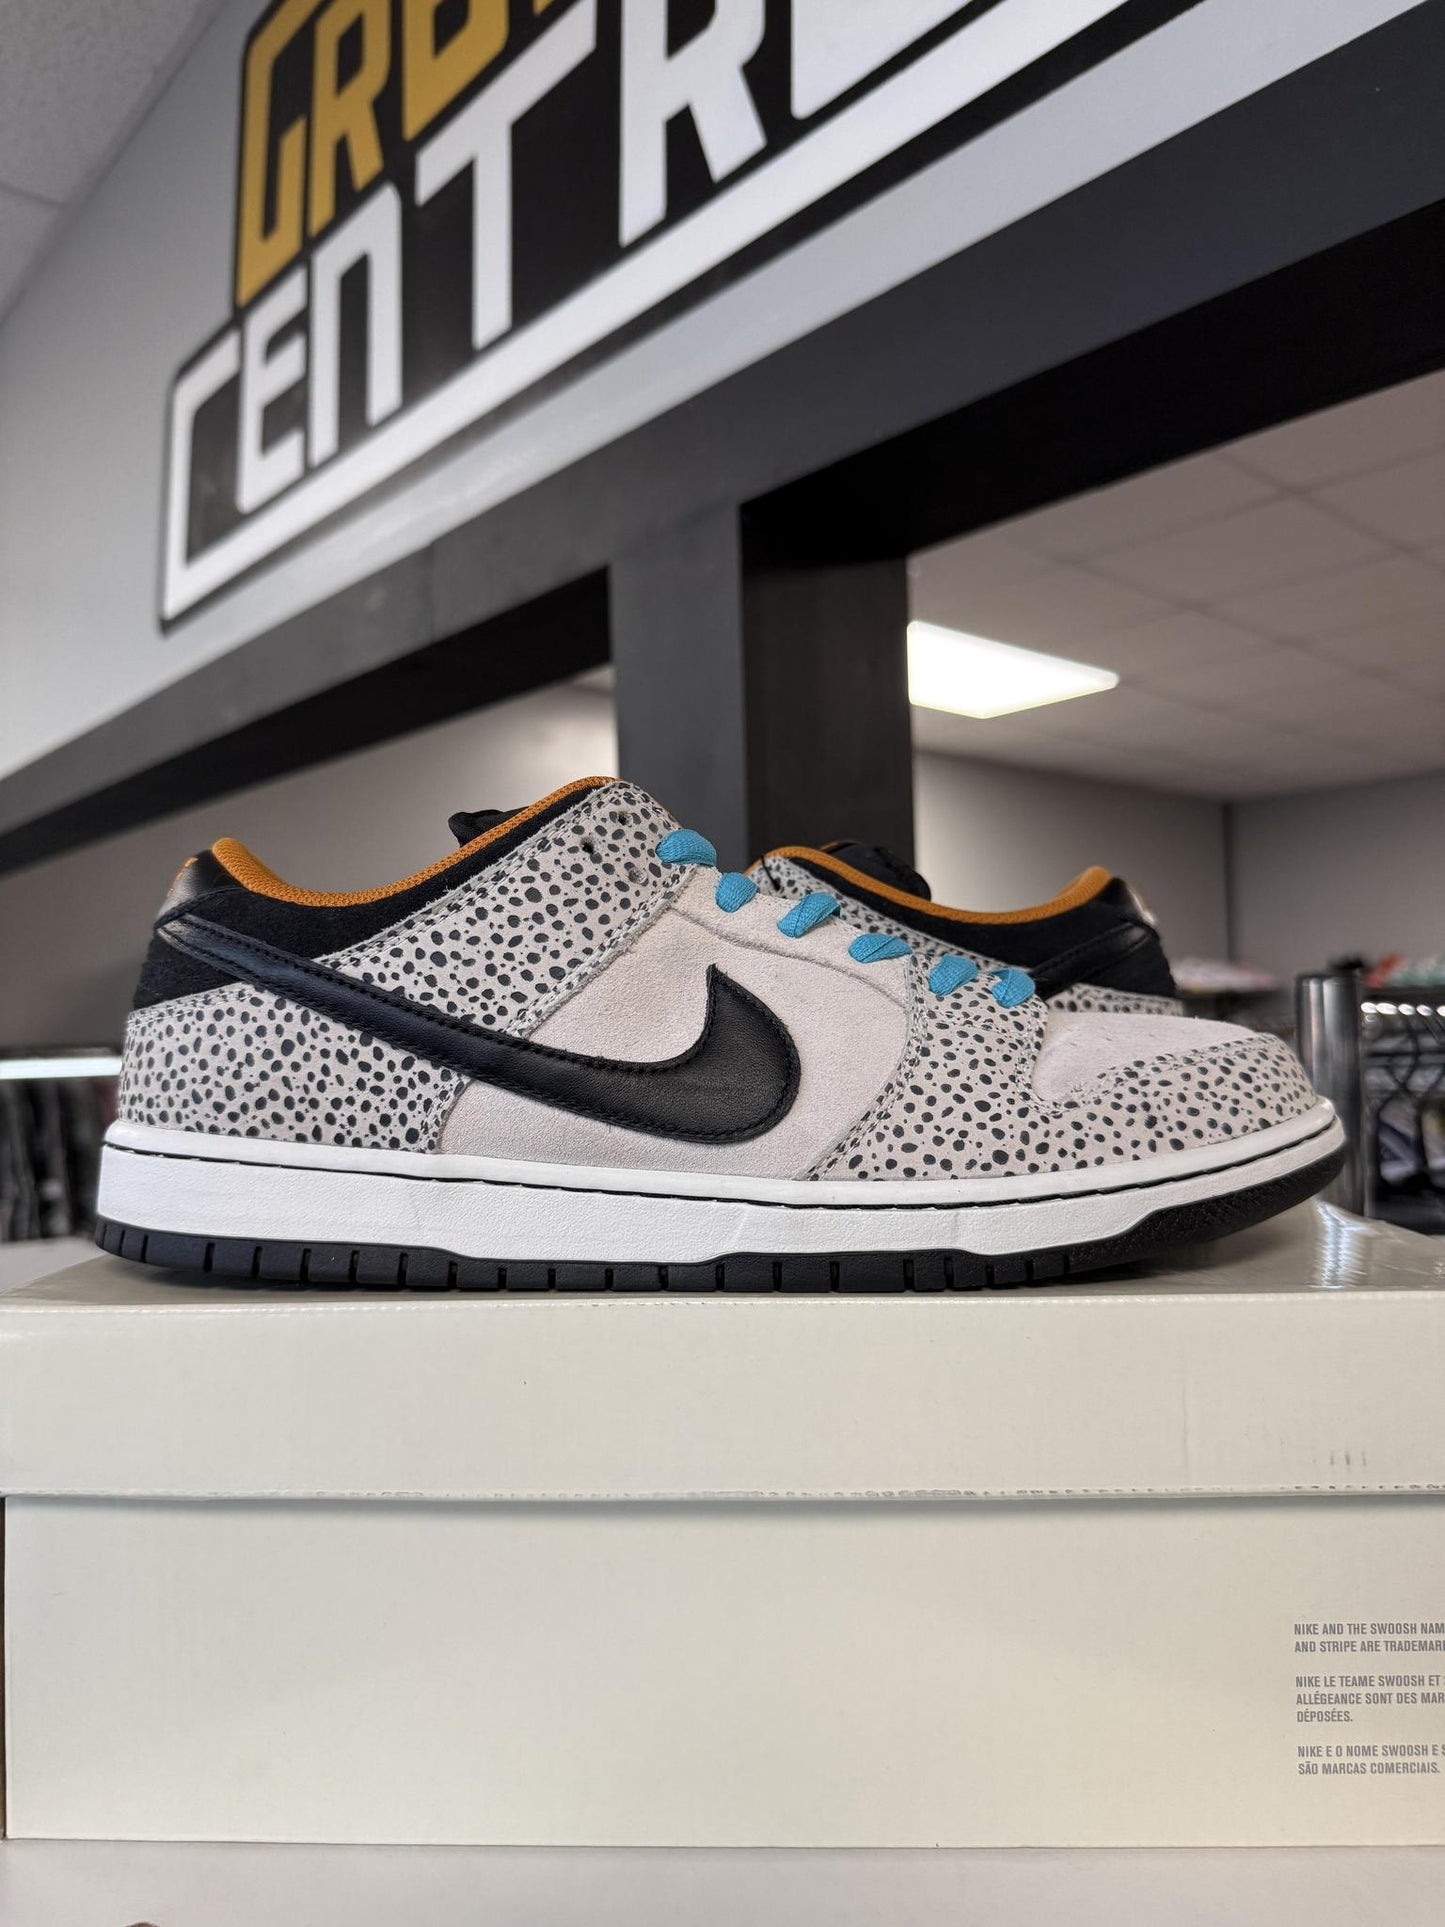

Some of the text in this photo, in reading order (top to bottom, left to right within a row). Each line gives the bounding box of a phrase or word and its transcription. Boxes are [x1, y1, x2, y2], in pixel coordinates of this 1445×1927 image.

[162, 0, 980, 620] CENTR
[1294, 1623, 1319, 1635] NIKE
[1322, 1623, 1344, 1635] AND
[1347, 1623, 1367, 1635] THE
[1370, 1622, 1417, 1635] SWOOSH
[1295, 1641, 1316, 1653] AND
[1320, 1641, 1357, 1652] STRIPE
[1360, 1641, 1381, 1652] ARE
[1296, 1676, 1321, 1687] NIKE
[1324, 1676, 1336, 1687] LE
[1378, 1675, 1425, 1687] SWOOSH
[1428, 1674, 1441, 1686] ET
[1296, 1691, 1362, 1705] ALLÉGEANCE
[1365, 1692, 1393, 1704] SONT
[1396, 1692, 1417, 1704] DES
[1297, 1708, 1353, 1722] DÉPOSÉES.
[1298, 1746, 1323, 1757] NIKE
[1326, 1746, 1332, 1757] E
[1335, 1746, 1343, 1757] O
[1346, 1745, 1379, 1757] NOME
[1381, 1744, 1429, 1757] SWOOSH
[1431, 1744, 1439, 1756] E
[1298, 1761, 1441, 1775] SÃO MARCAS COMERCIAIS.
